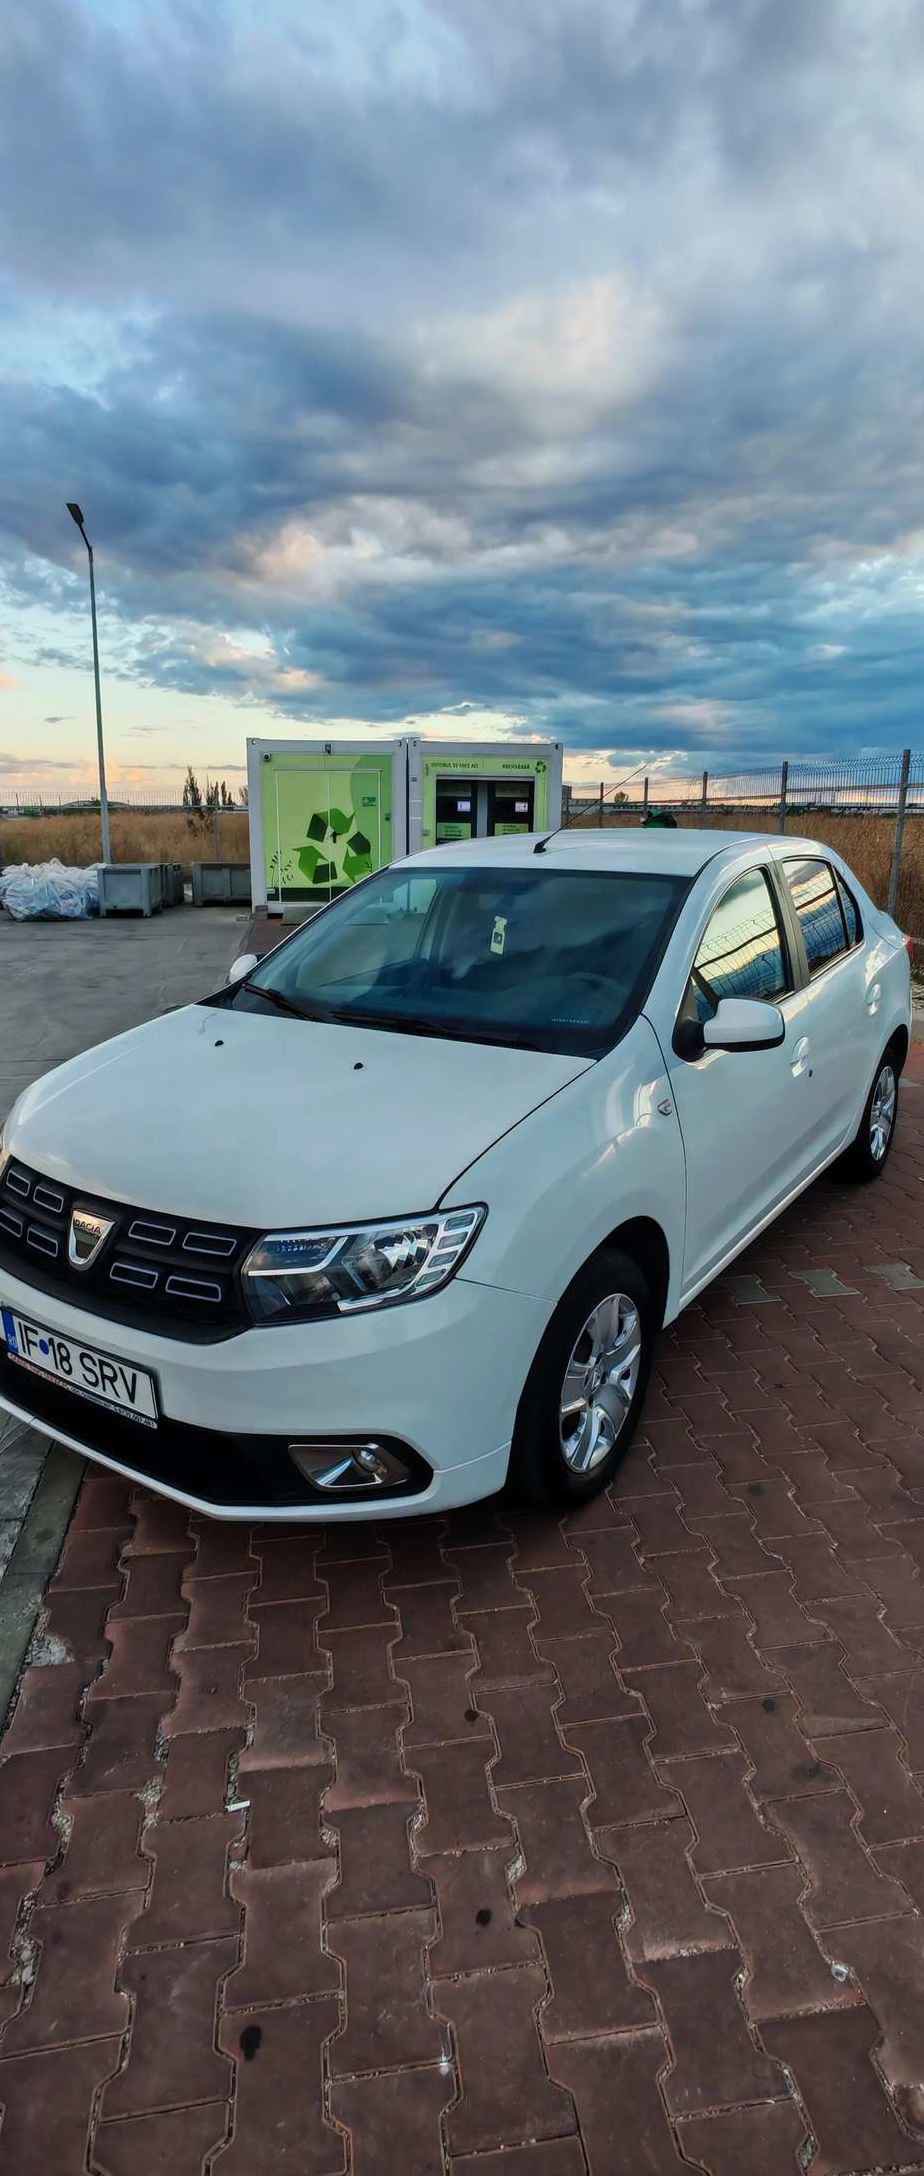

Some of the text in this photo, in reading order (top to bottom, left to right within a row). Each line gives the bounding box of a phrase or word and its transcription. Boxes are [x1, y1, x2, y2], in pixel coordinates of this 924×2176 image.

[73, 1218, 101, 1234] DACIA
[48, 1337, 73, 1376] 18
[79, 1351, 137, 1404] SRV
